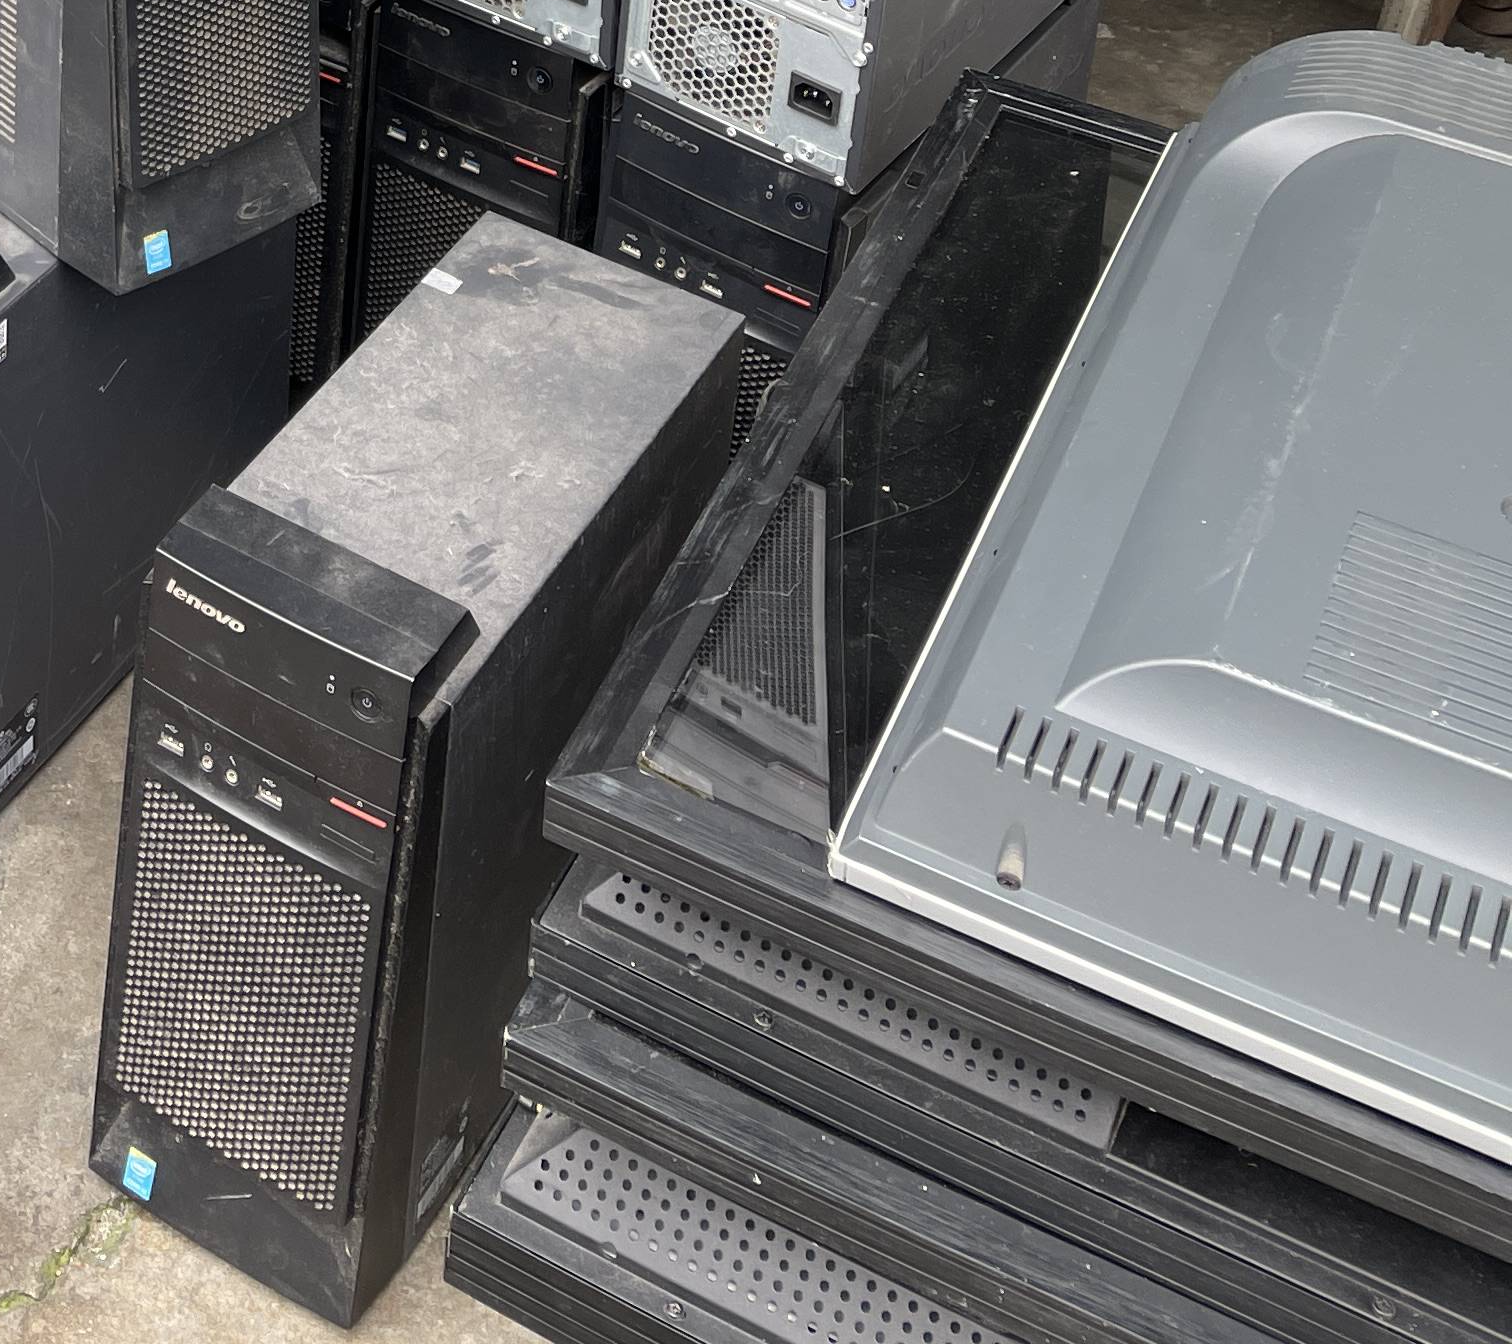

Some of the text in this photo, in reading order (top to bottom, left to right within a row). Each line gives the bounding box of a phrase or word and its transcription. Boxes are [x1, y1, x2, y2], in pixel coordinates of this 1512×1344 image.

[391, 2, 450, 37] lenovo
[633, 113, 700, 154] lenovo
[166, 578, 246, 633] lenovo
